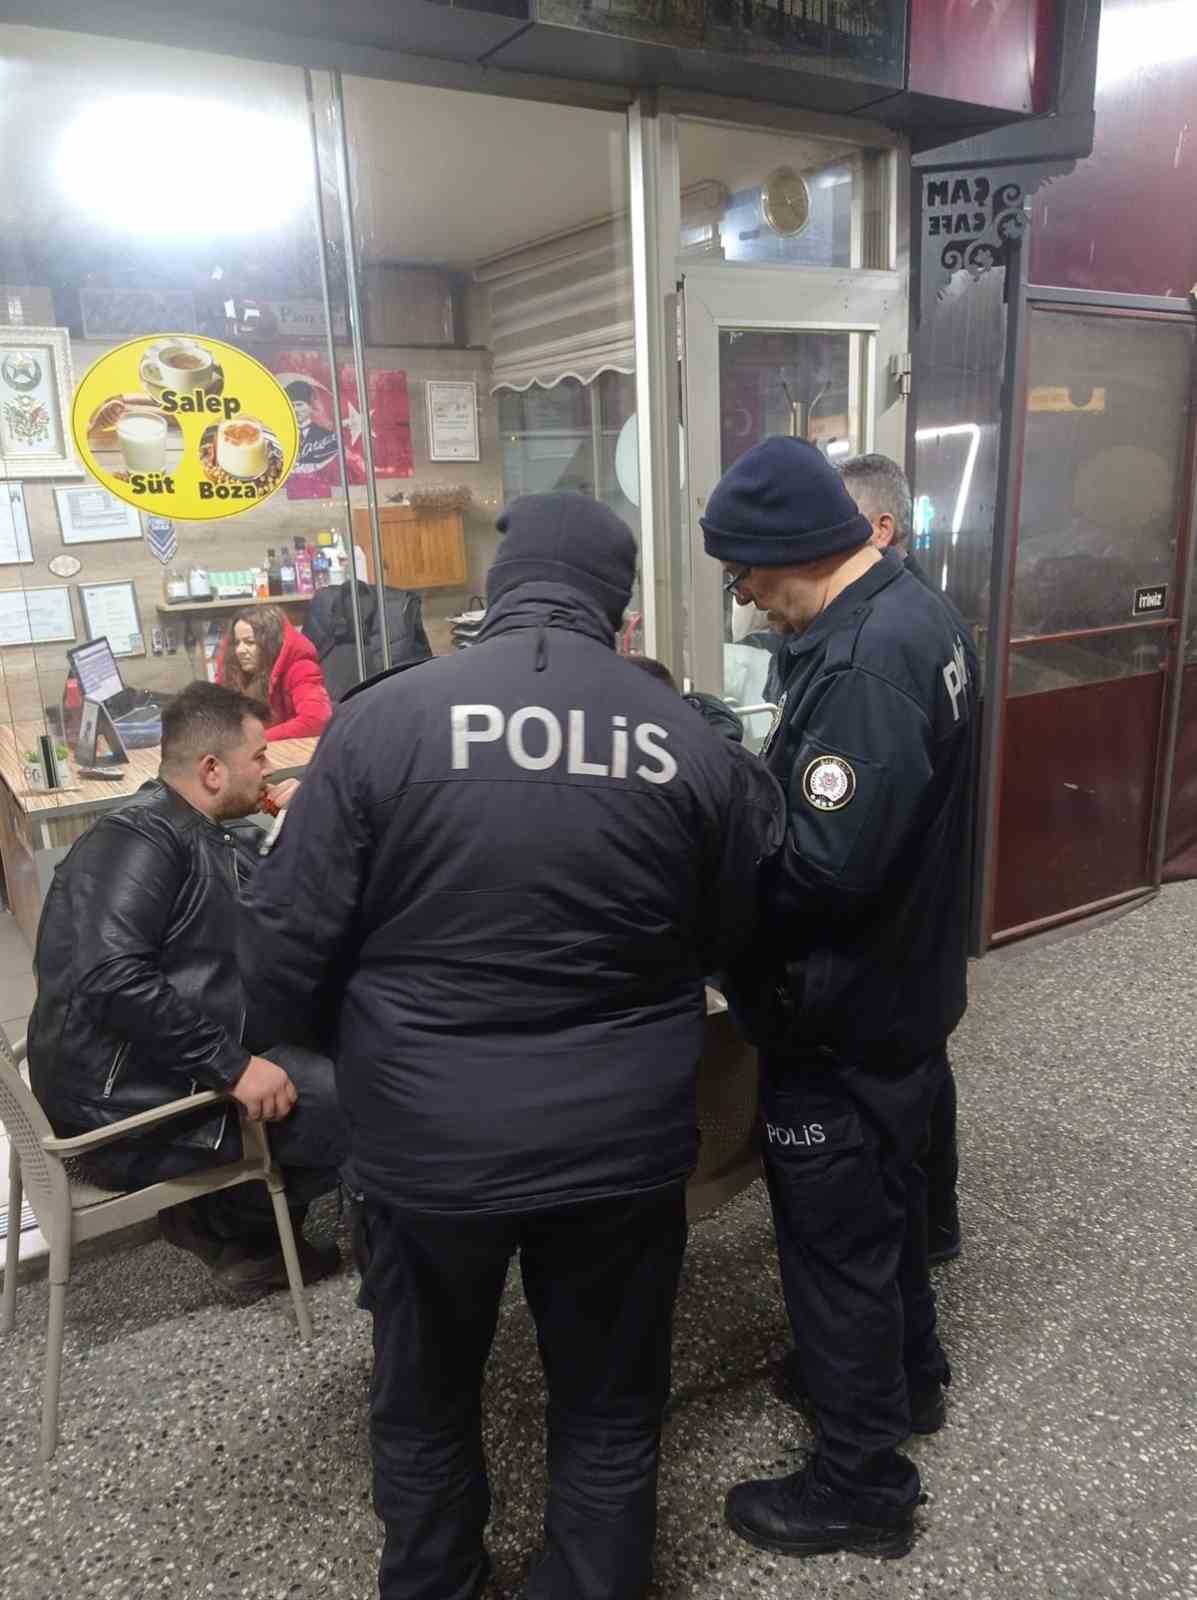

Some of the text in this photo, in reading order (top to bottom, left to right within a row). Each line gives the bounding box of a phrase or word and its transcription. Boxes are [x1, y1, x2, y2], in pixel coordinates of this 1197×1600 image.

[161, 390, 241, 420] Salep
[131, 474, 175, 494] Süt
[199, 481, 256, 499] Boza
